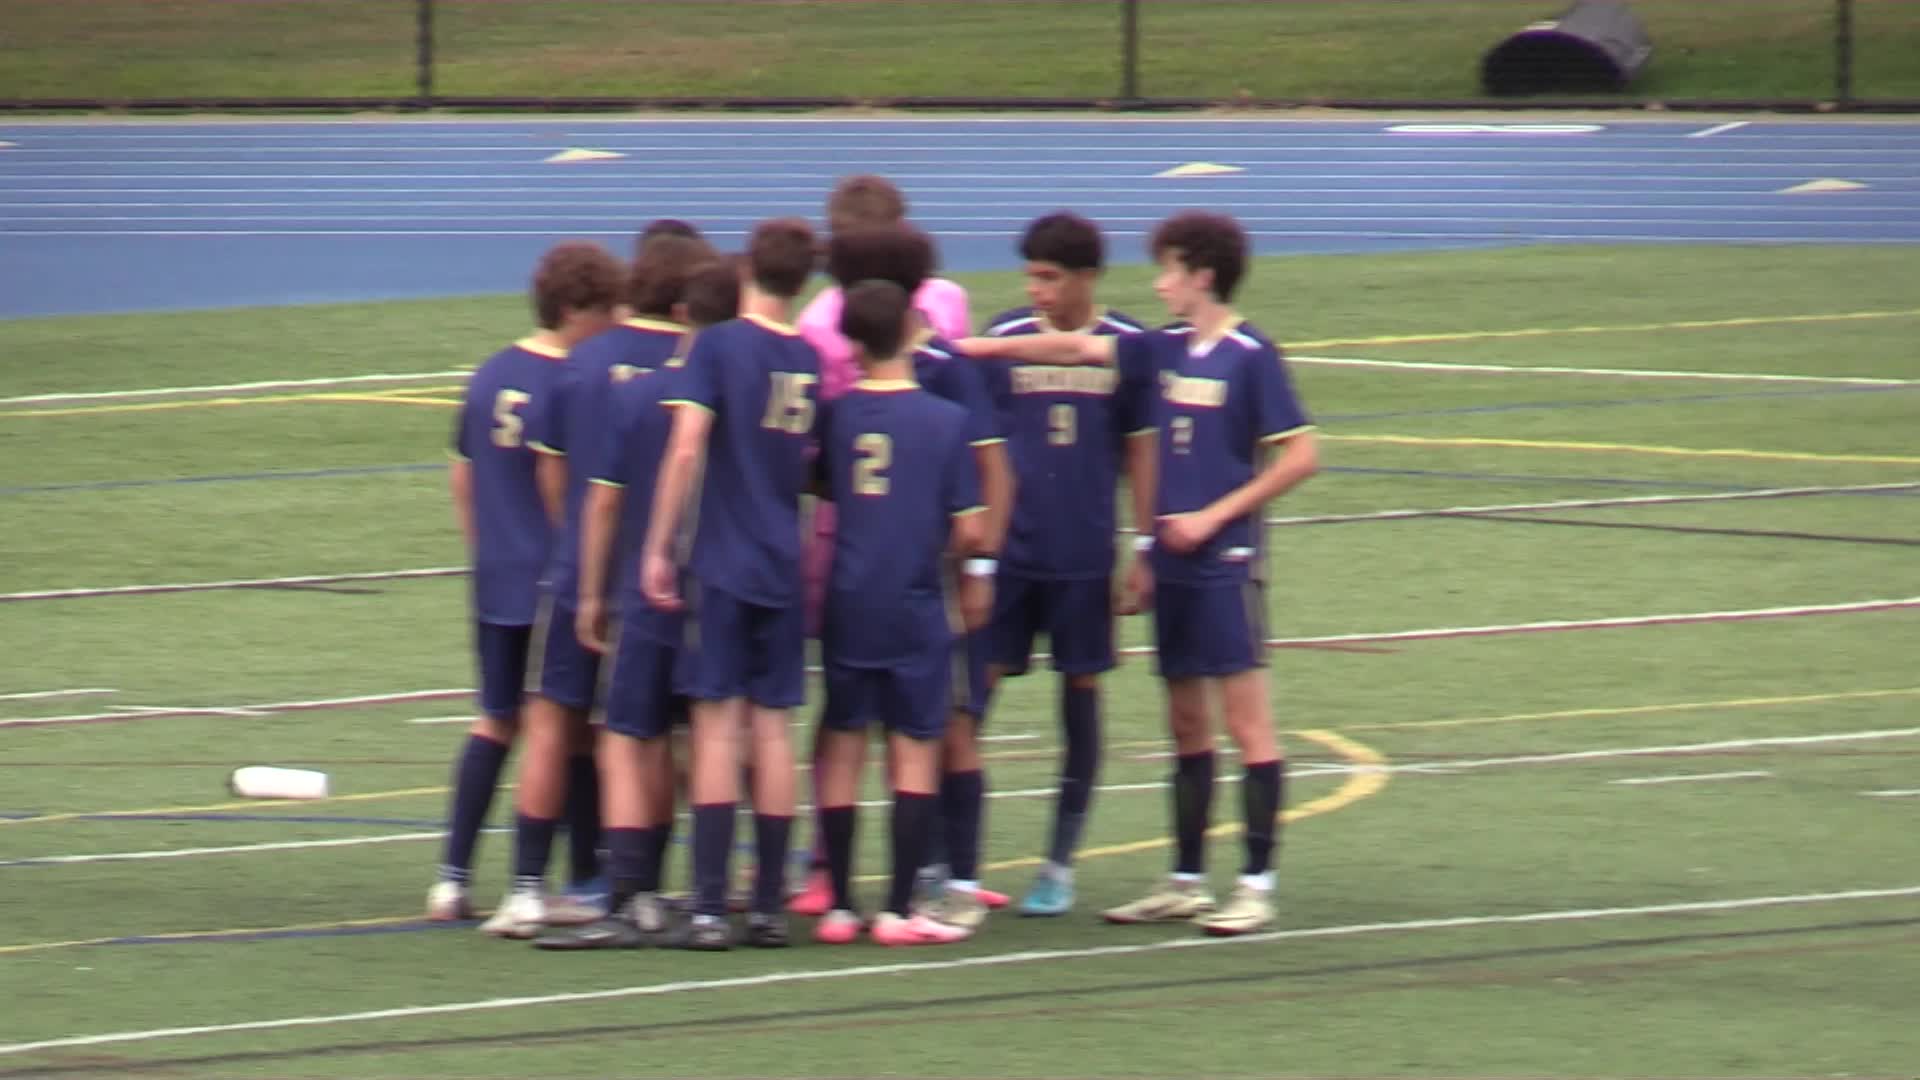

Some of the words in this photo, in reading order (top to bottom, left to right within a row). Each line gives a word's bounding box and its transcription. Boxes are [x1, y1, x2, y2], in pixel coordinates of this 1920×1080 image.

[491, 389, 531, 448] 5
[1047, 403, 1078, 445] 9
[853, 433, 892, 494] 2
